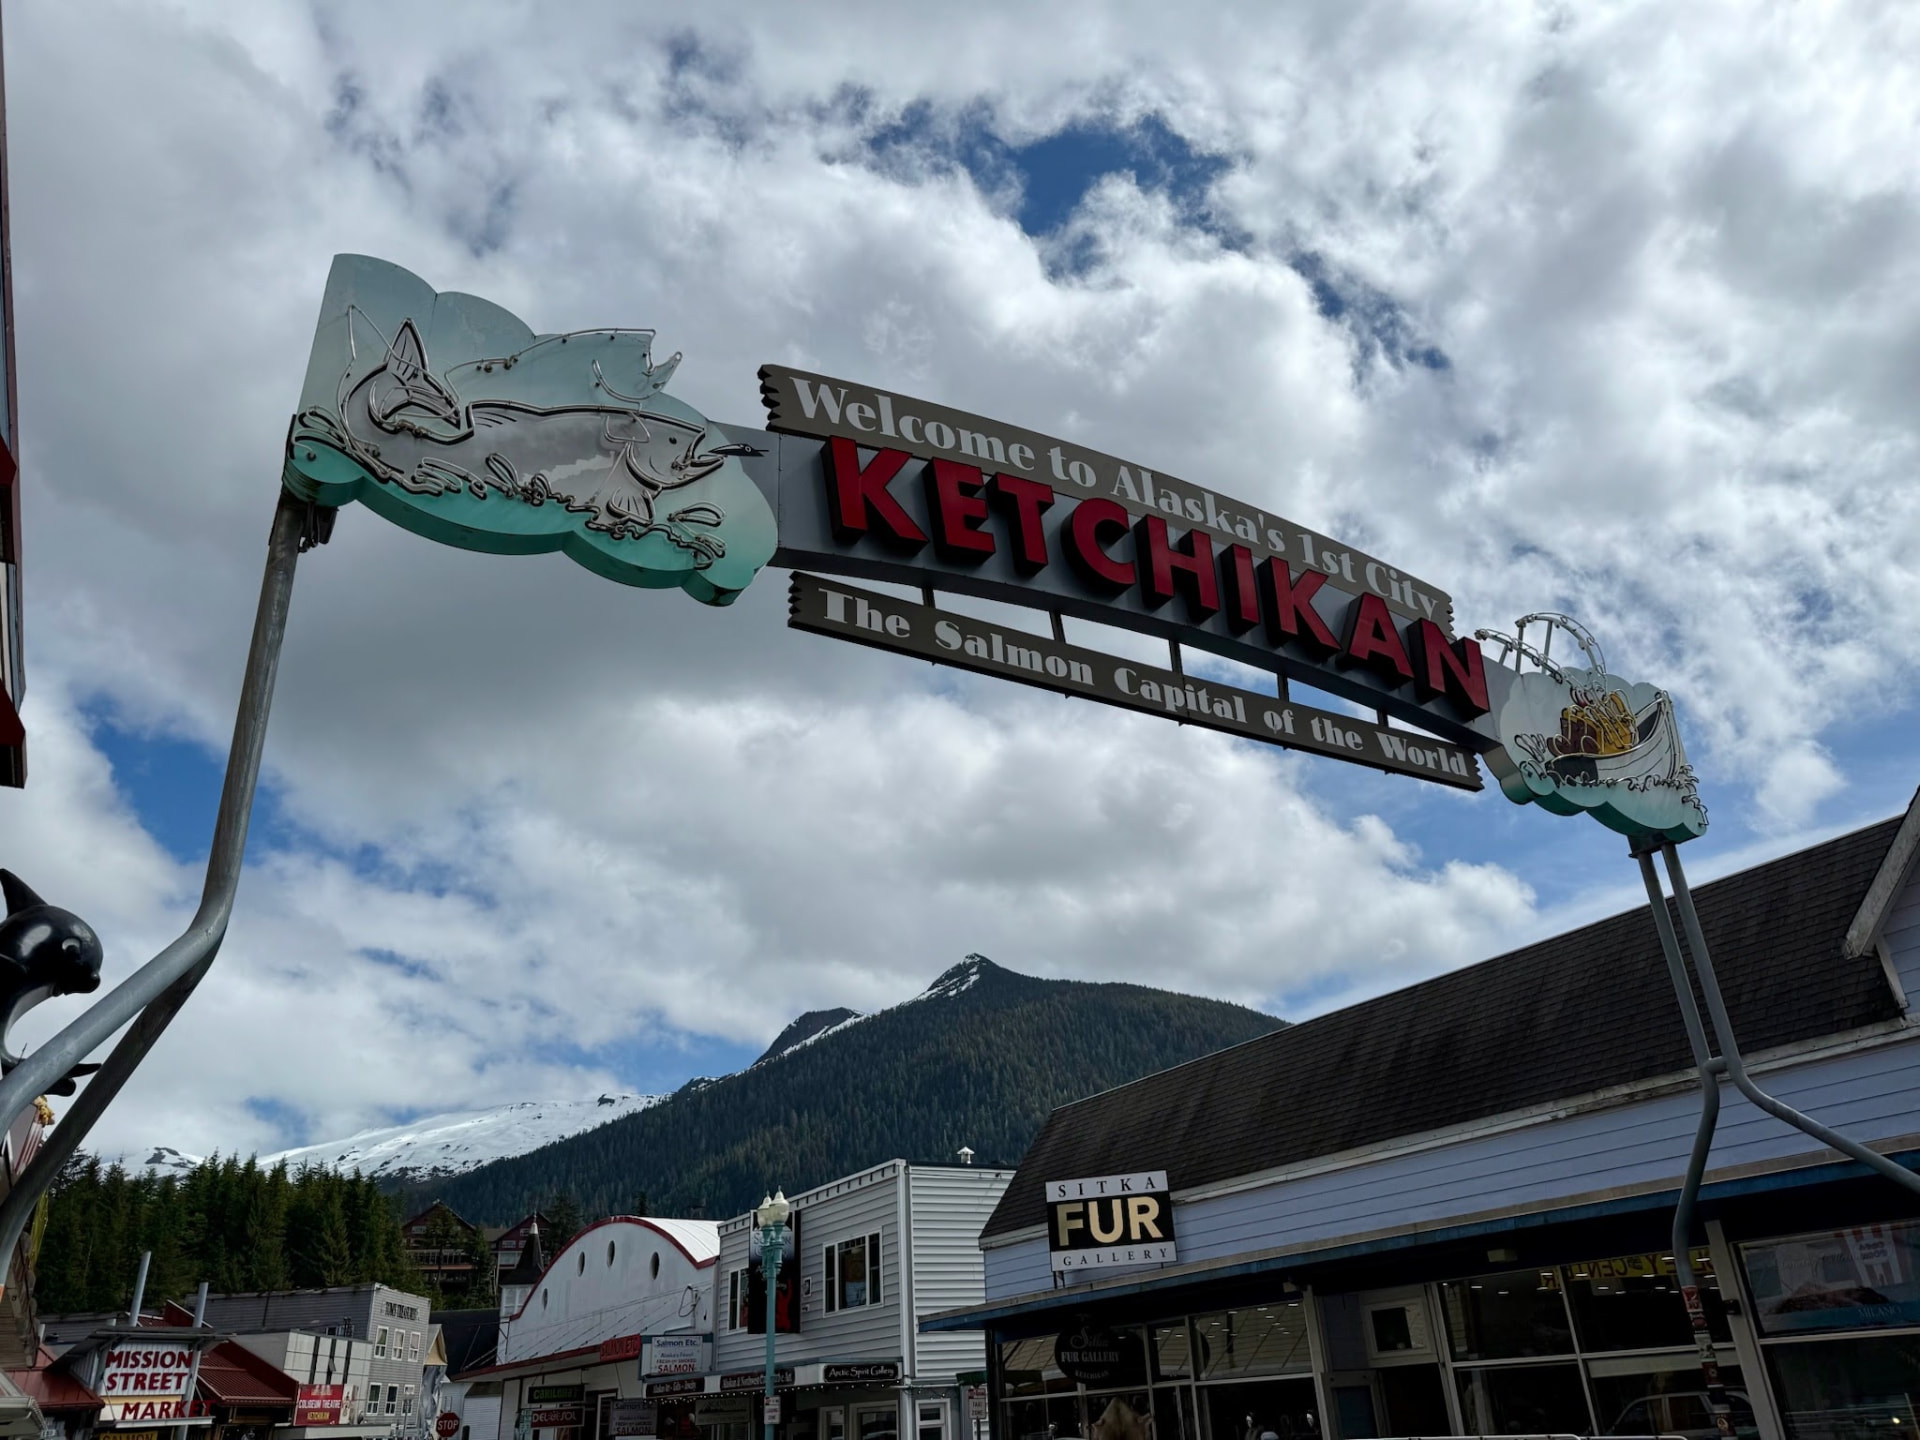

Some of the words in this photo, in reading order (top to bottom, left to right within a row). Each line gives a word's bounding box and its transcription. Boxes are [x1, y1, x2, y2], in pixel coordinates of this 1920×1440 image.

[789, 376, 1035, 471] Welcome
[1047, 446, 1097, 488] to
[1110, 465, 1285, 553] Alaska's
[1298, 533, 1357, 583] 1st
[1365, 560, 1439, 621] City
[829, 436, 1489, 714] KETCHIKAN
[818, 587, 911, 638] The
[934, 620, 1095, 686] Salmon
[1113, 667, 1247, 724] Capital
[1263, 708, 1296, 736] of
[1310, 716, 1364, 752] the
[1374, 731, 1471, 778] World
[1058, 1176, 1156, 1198] SITKA
[1056, 1196, 1164, 1247] FUR
[1063, 1248, 1167, 1266] GALLERY
[656, 1339, 684, 1348] Salmon
[685, 1339, 699, 1347] Etc.
[105, 1350, 194, 1369] MISSION
[1061, 1351, 1080, 1363] FUR
[1081, 1351, 1120, 1363] GALLERY
[658, 1364, 695, 1374] SALMON
[828, 1368, 850, 1378] Arctic
[850, 1366, 869, 1379] Spirit
[870, 1365, 895, 1377] Gallery
[106, 1372, 188, 1391] STREET
[121, 1399, 216, 1421] MARKET
[437, 1419, 459, 1430] STOP
